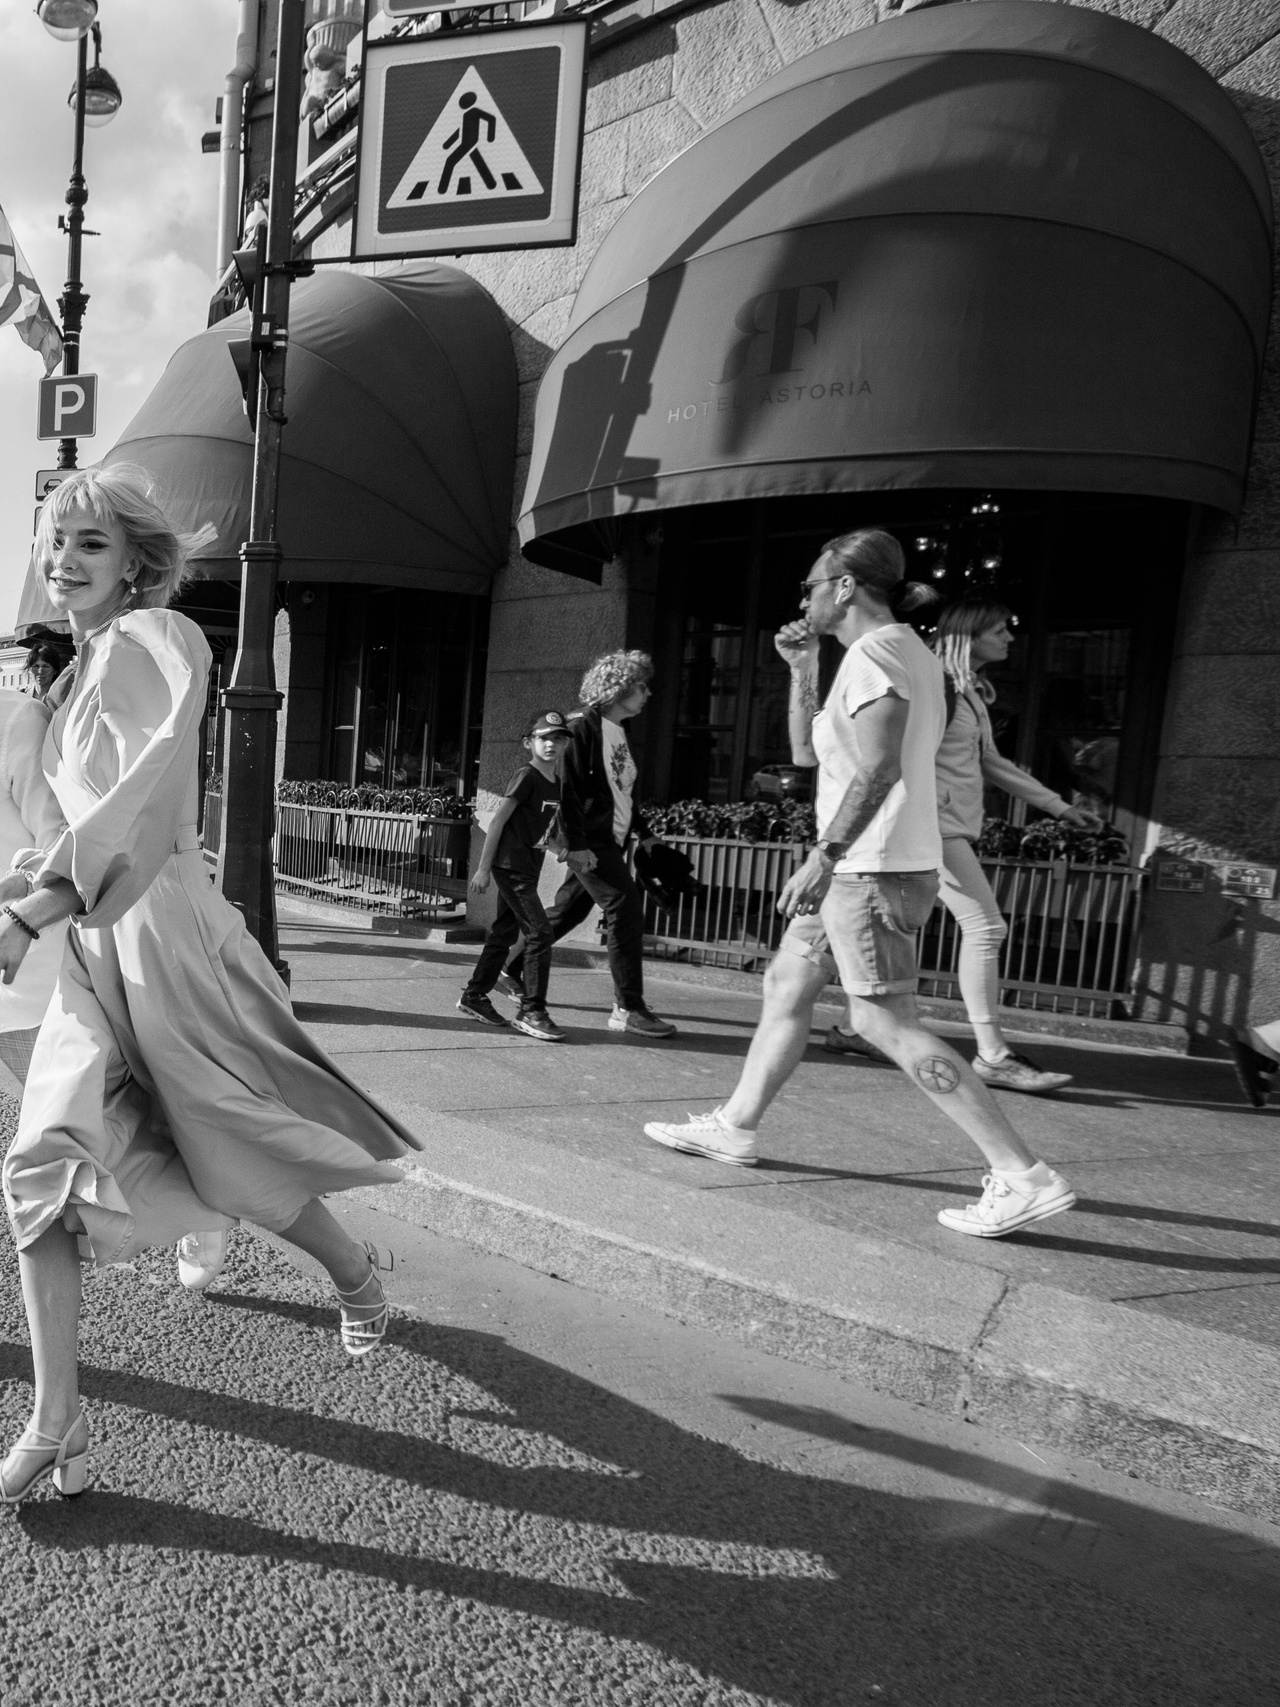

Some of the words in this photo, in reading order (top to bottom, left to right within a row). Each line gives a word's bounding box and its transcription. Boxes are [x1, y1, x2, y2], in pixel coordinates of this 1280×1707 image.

[54, 383, 86, 432] P
[666, 393, 744, 424] HOTEL
[759, 380, 873, 405] ASTORIA
